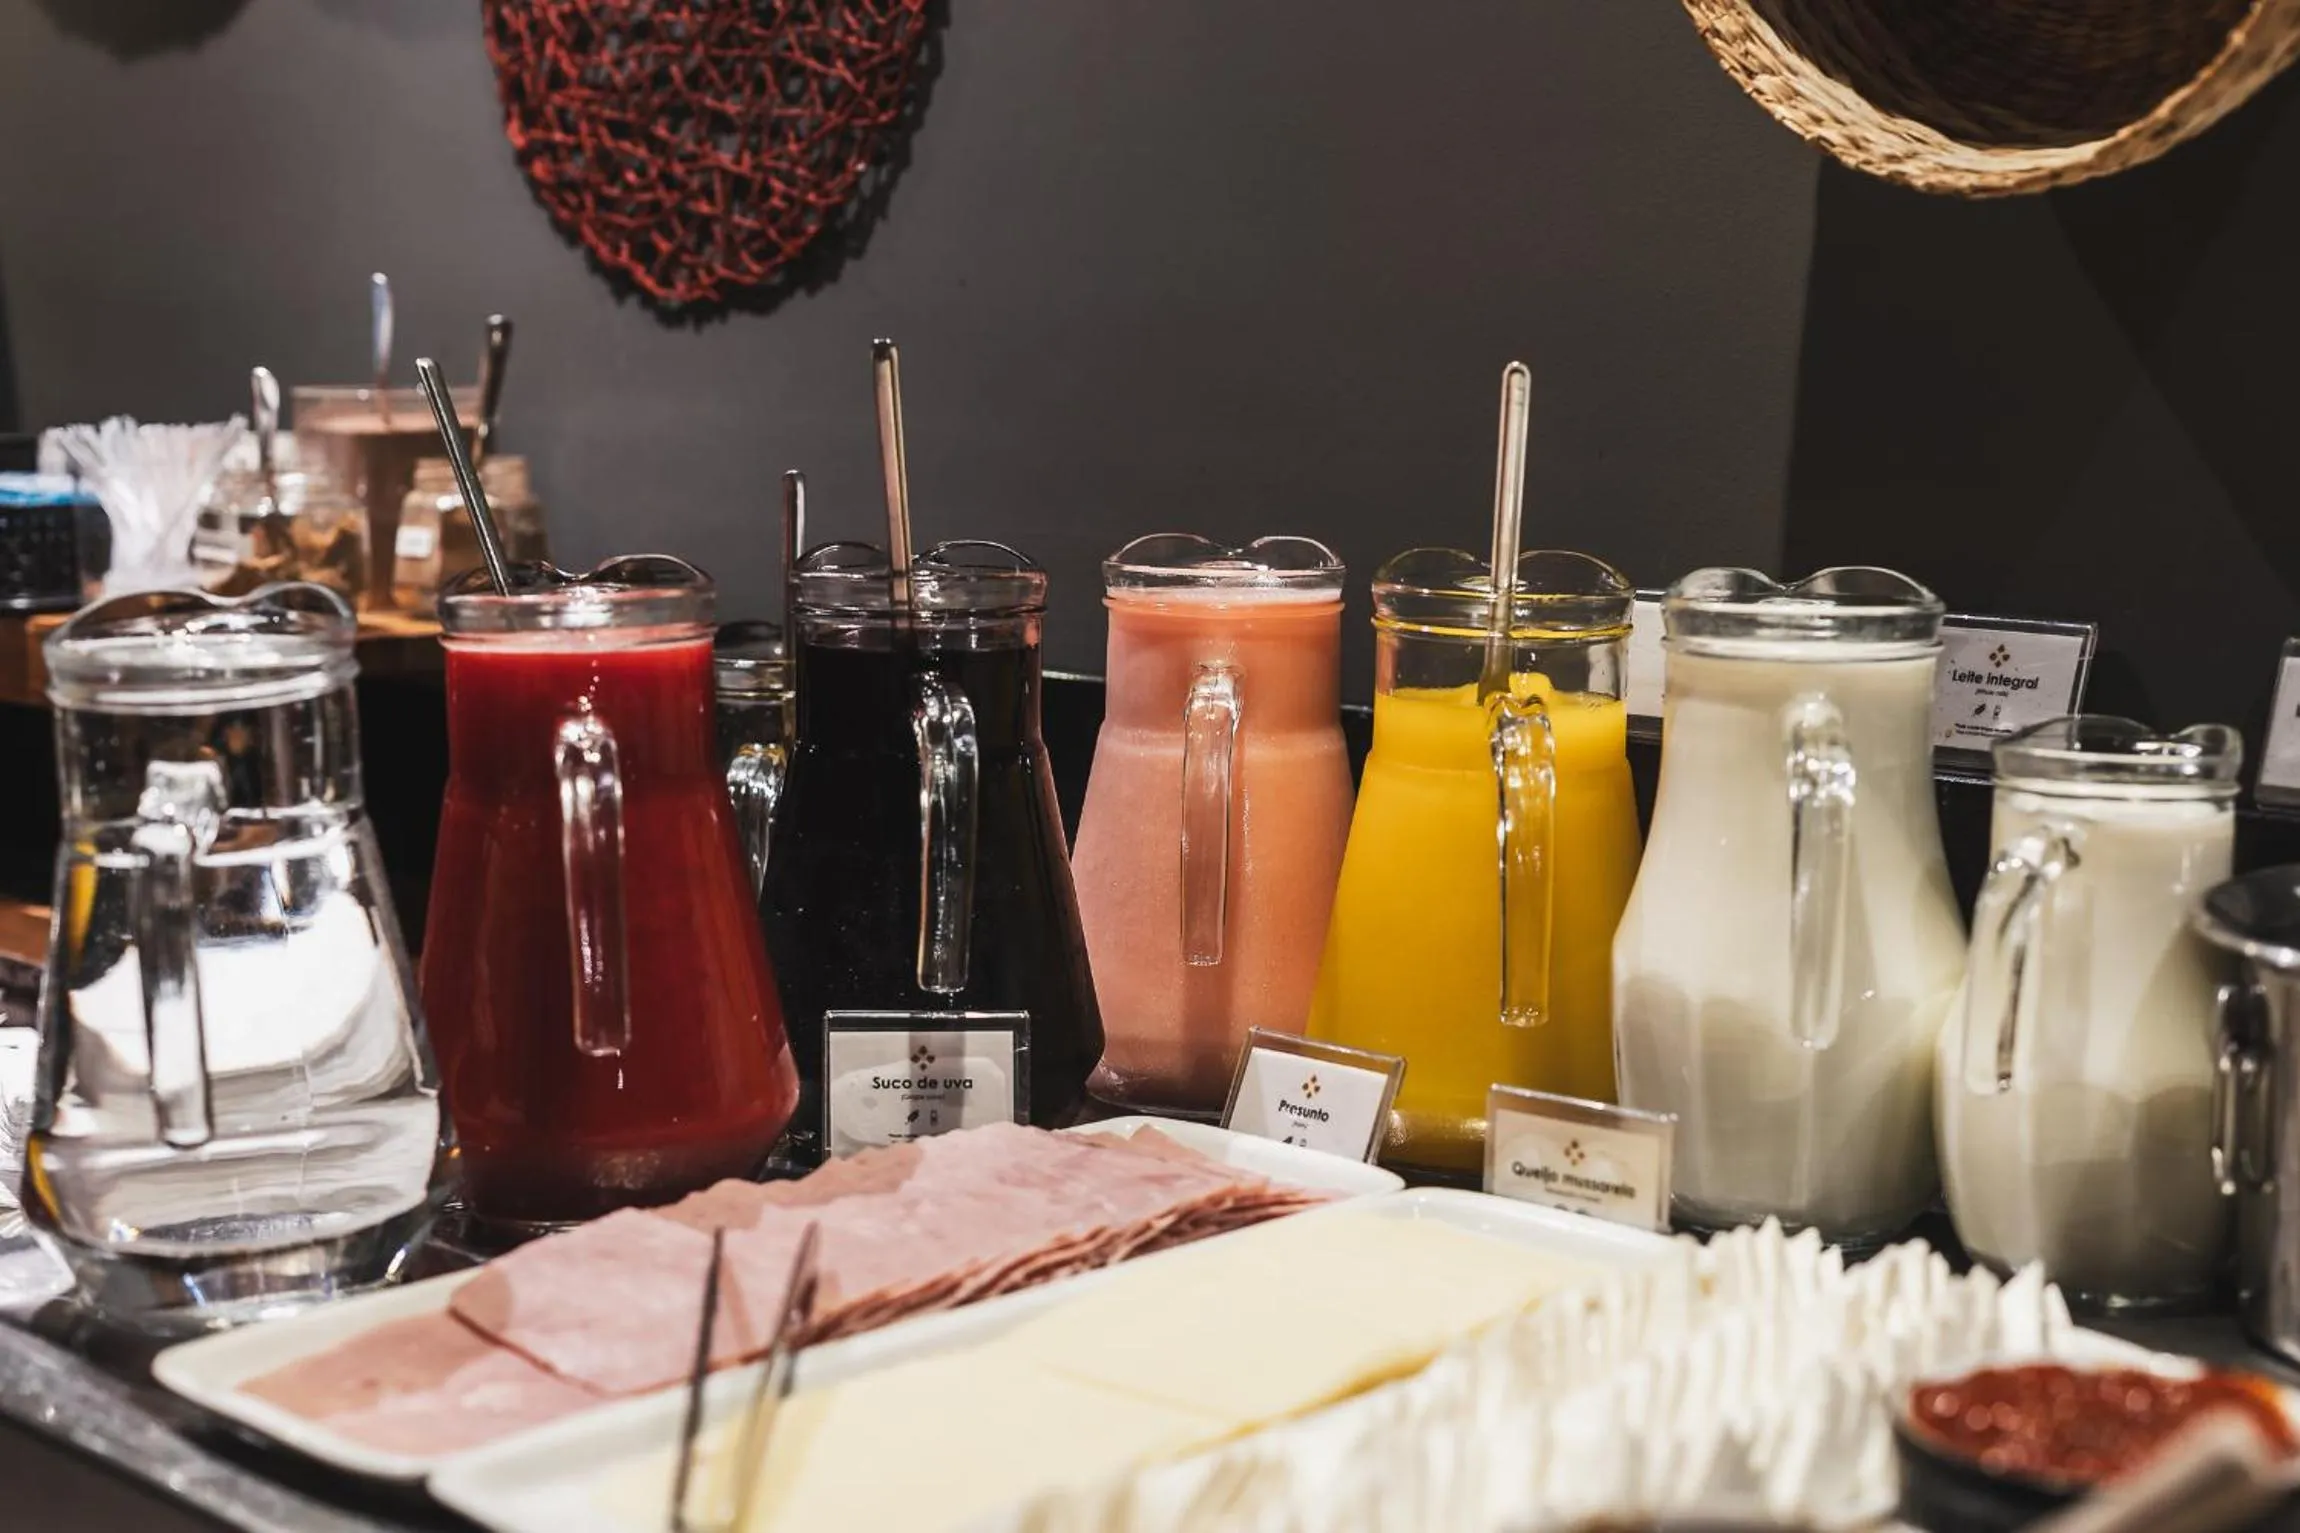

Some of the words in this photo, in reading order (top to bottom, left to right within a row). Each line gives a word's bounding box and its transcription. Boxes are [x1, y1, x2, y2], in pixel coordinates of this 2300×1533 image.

[1952, 669, 1983, 684] Leite
[872, 1076, 912, 1090] Suco
[917, 1076, 938, 1090] de
[943, 1078, 973, 1090] uva
[1278, 1099, 1330, 1122] Presunto
[1511, 1161, 1558, 1183] Queijo
